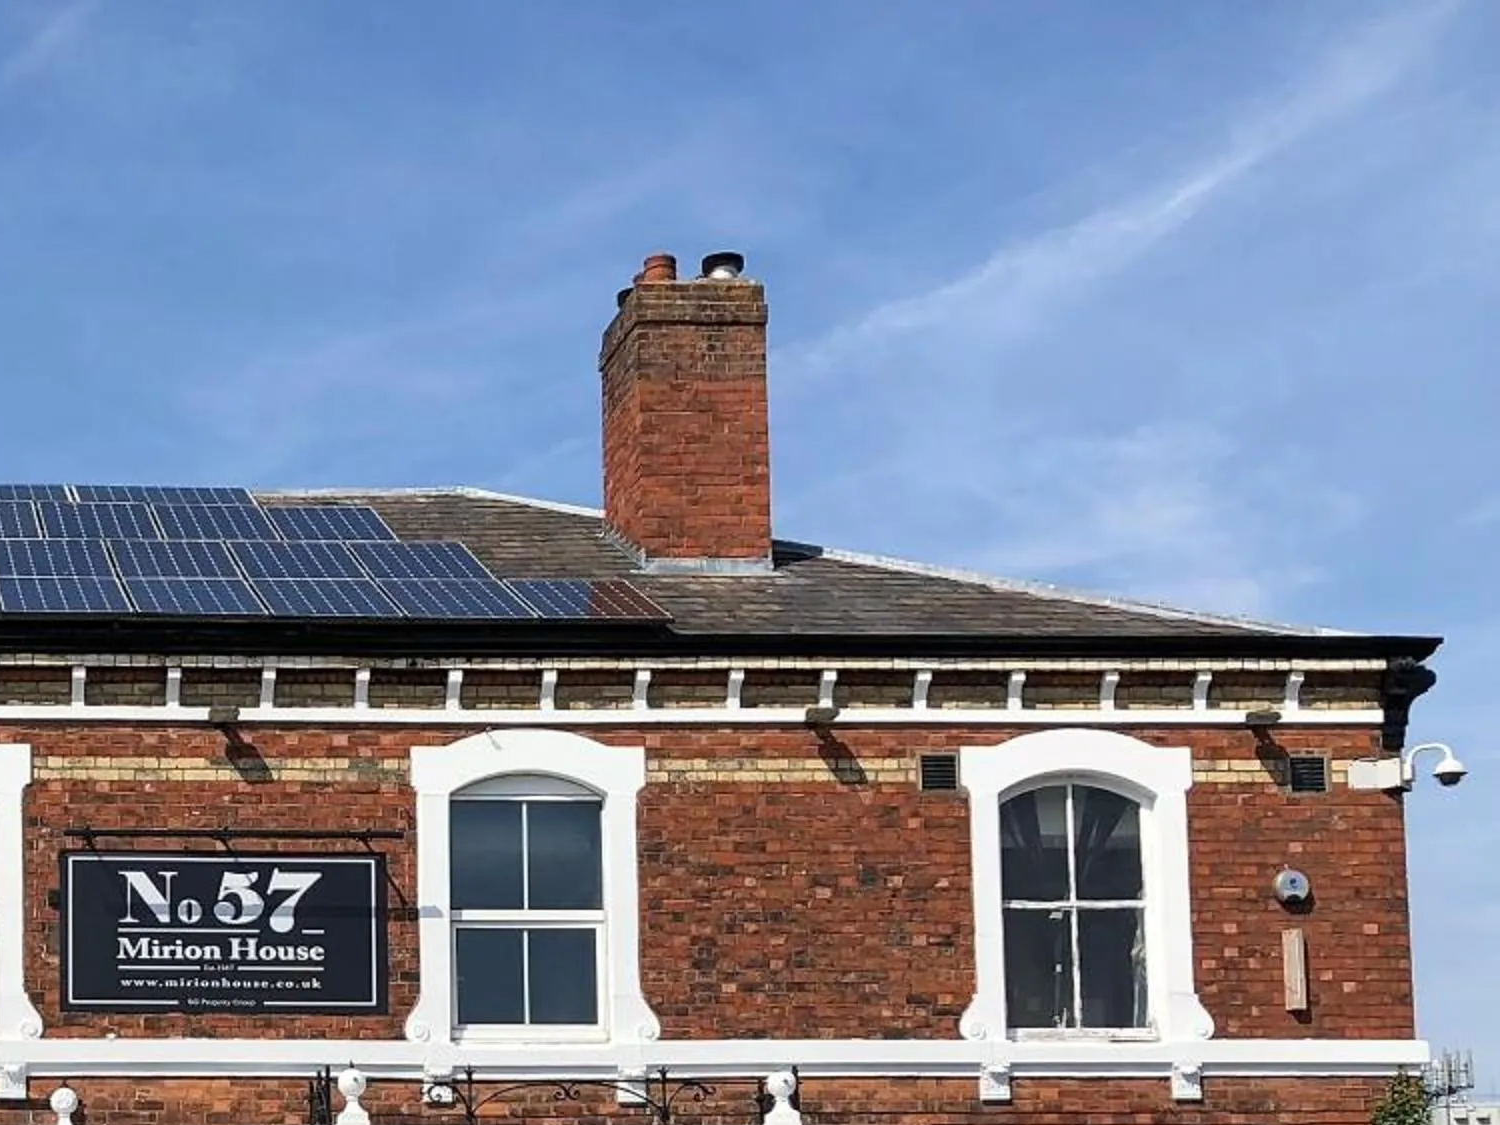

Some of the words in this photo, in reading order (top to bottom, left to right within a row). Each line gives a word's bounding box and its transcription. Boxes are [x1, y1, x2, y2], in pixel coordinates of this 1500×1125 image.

[117, 870, 203, 924] No
[213, 867, 323, 934] 57
[116, 936, 222, 961] Mirion
[228, 937, 325, 962] House
[119, 977, 323, 989] www.mirionhouse.co.uk
